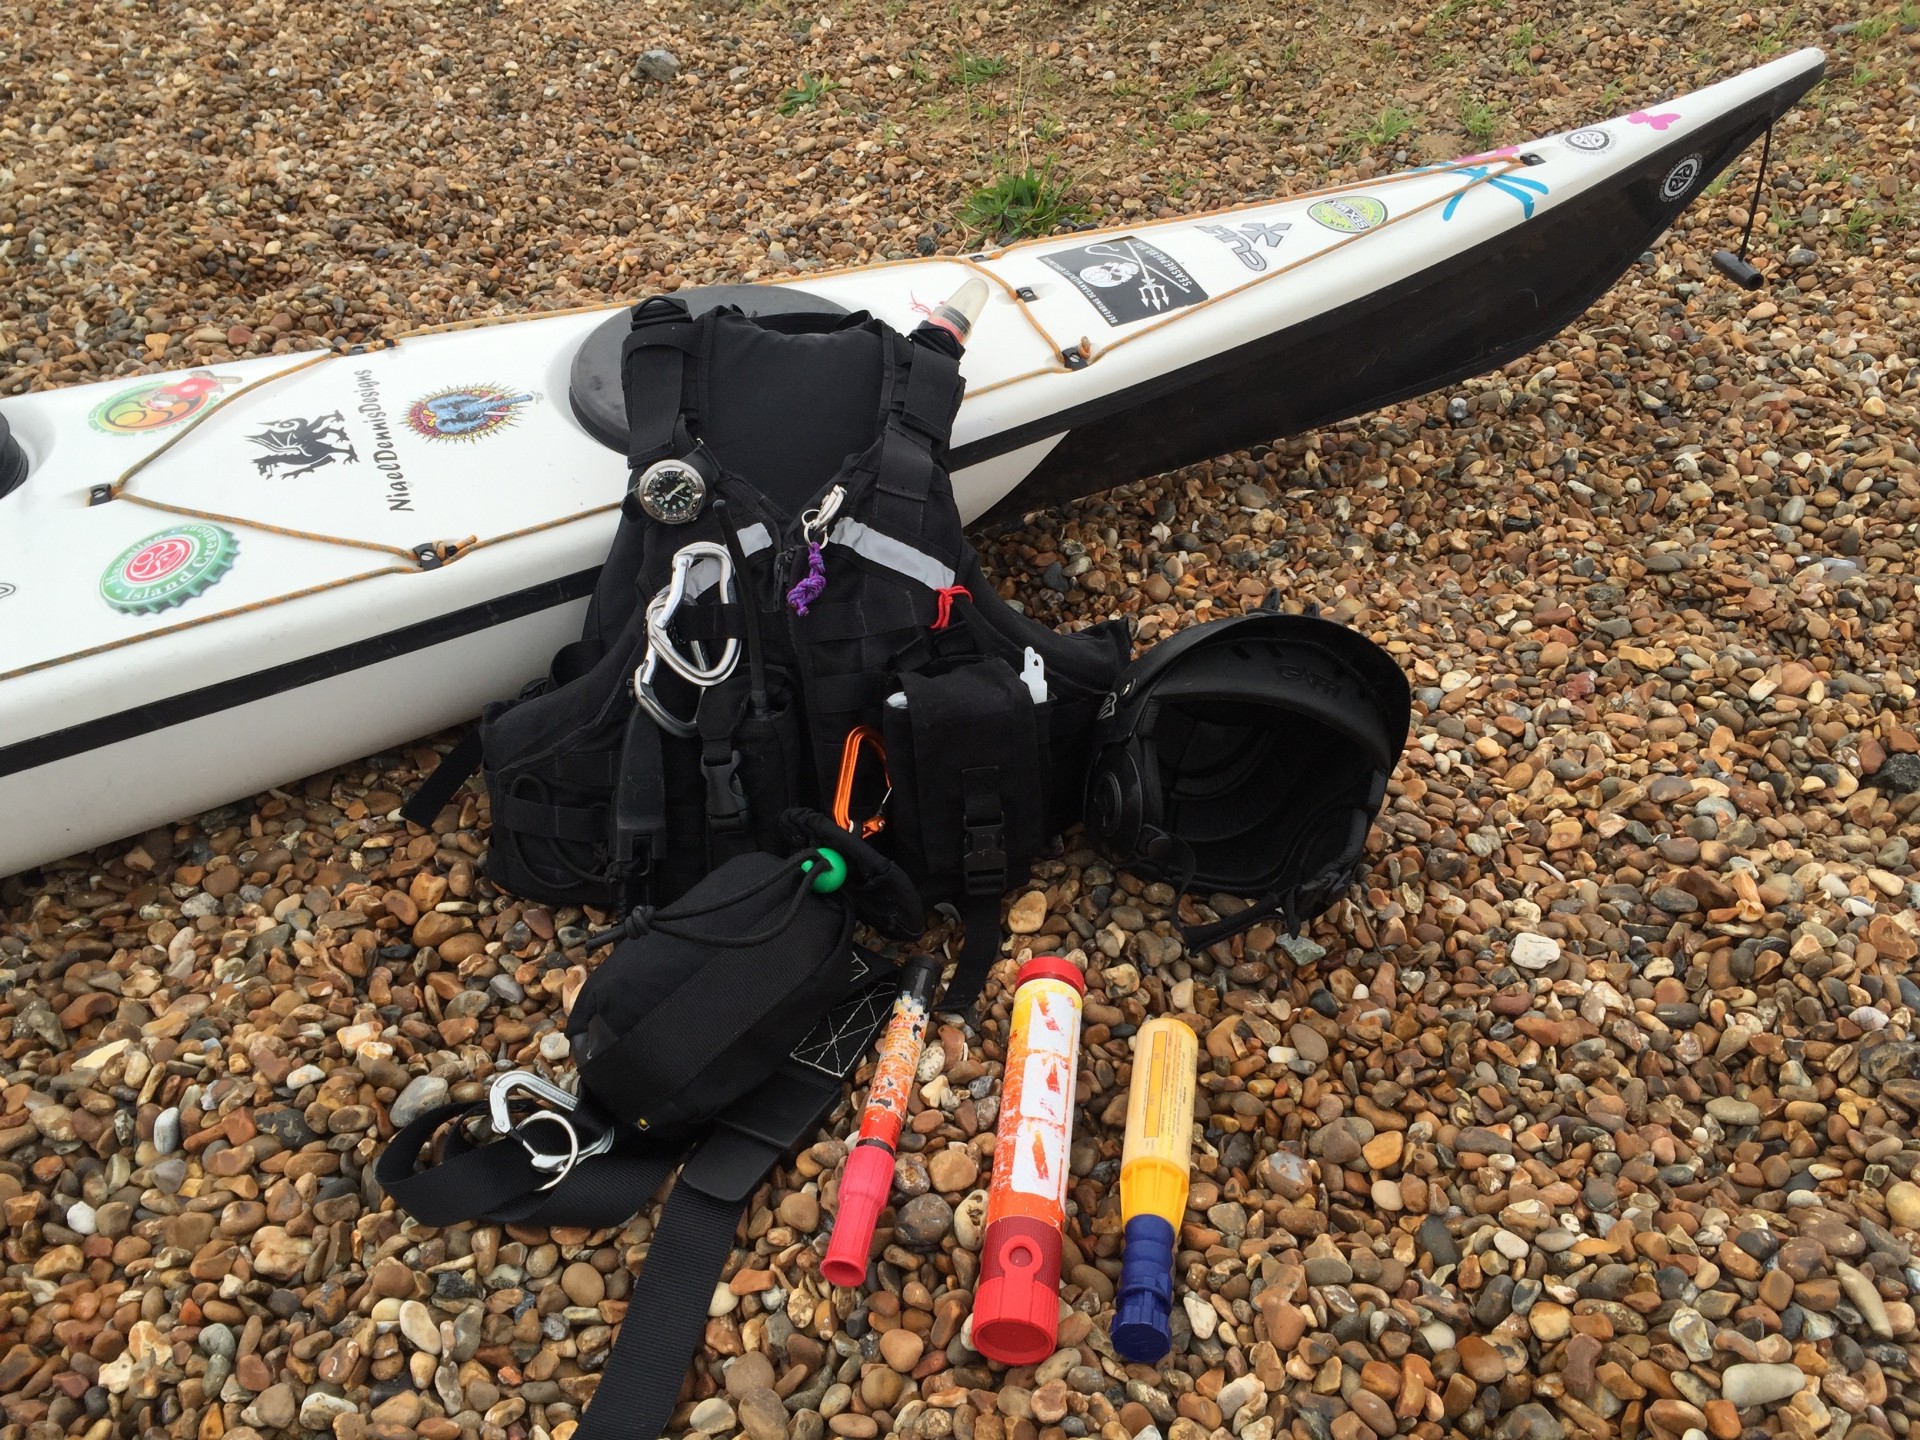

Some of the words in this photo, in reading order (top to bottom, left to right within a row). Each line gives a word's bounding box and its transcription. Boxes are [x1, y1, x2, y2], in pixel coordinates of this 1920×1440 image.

[1346, 211, 1370, 229] SEX
[1092, 297, 1119, 324] DEFENDING
[123, 570, 194, 600] Island
